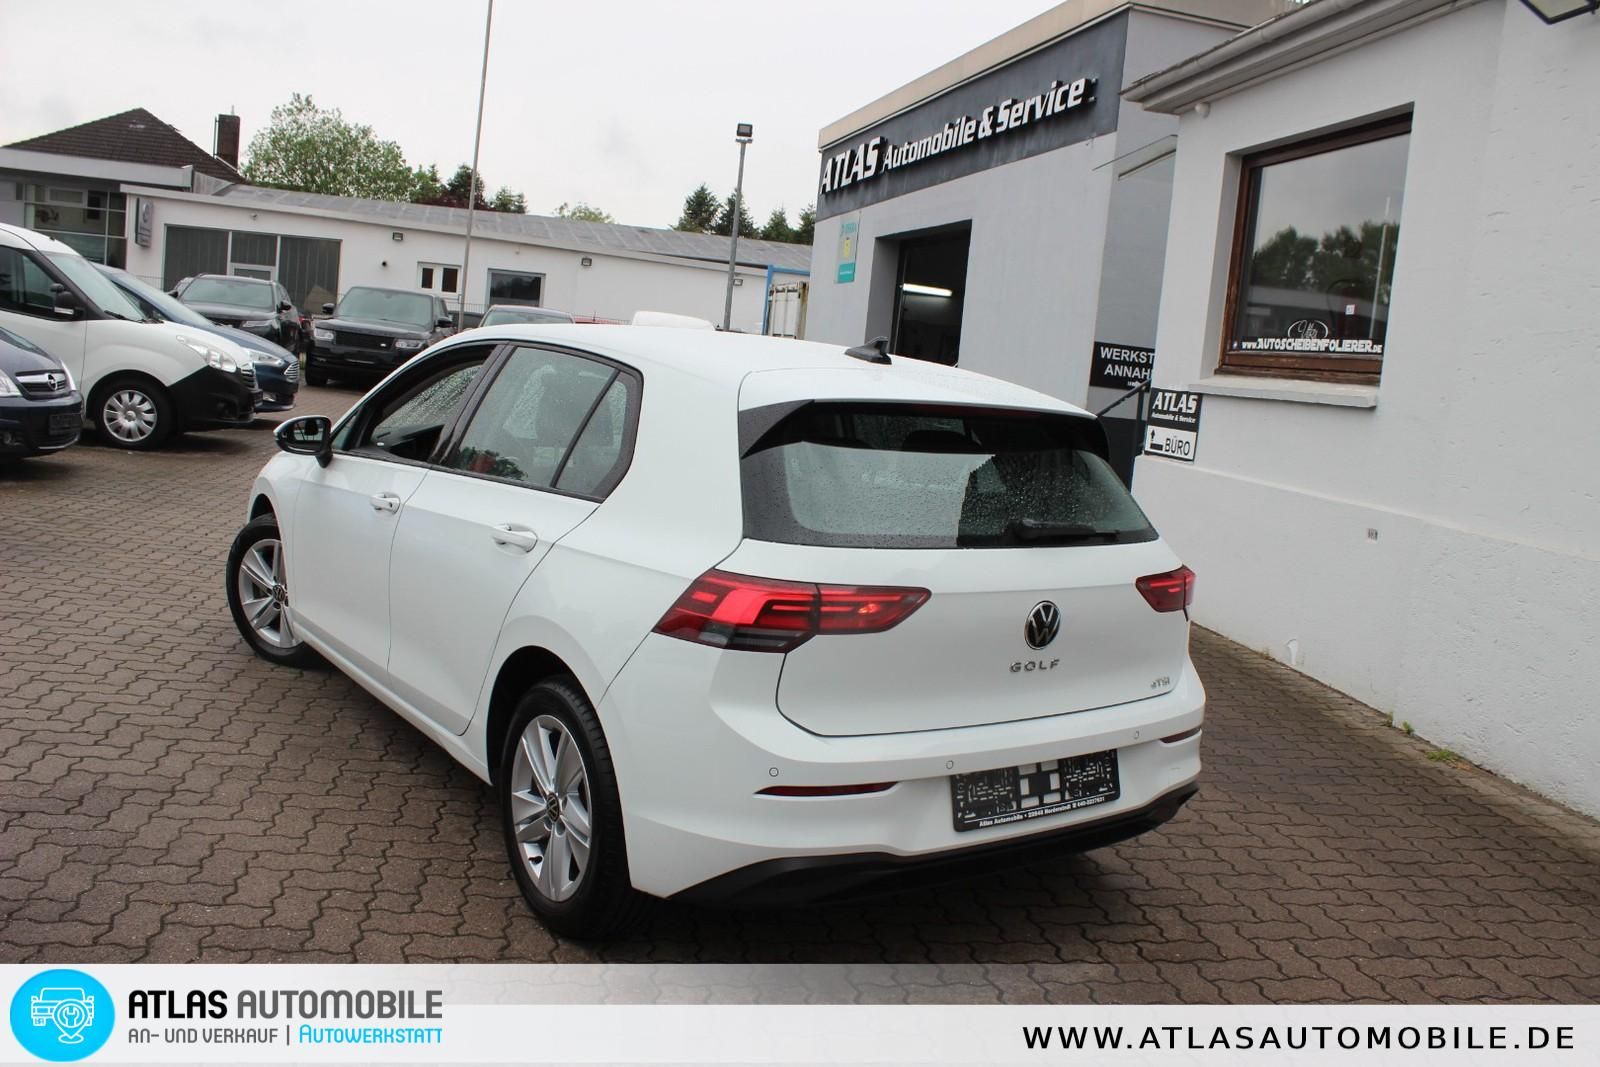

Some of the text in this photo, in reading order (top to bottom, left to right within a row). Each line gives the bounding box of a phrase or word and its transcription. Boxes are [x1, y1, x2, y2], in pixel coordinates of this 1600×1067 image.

[820, 77, 1086, 194] ATLAS Automobile & Service
[1152, 391, 1198, 414] ATLAS
[1165, 435, 1191, 456] BÜRO
[1010, 658, 1060, 673] GOLF
